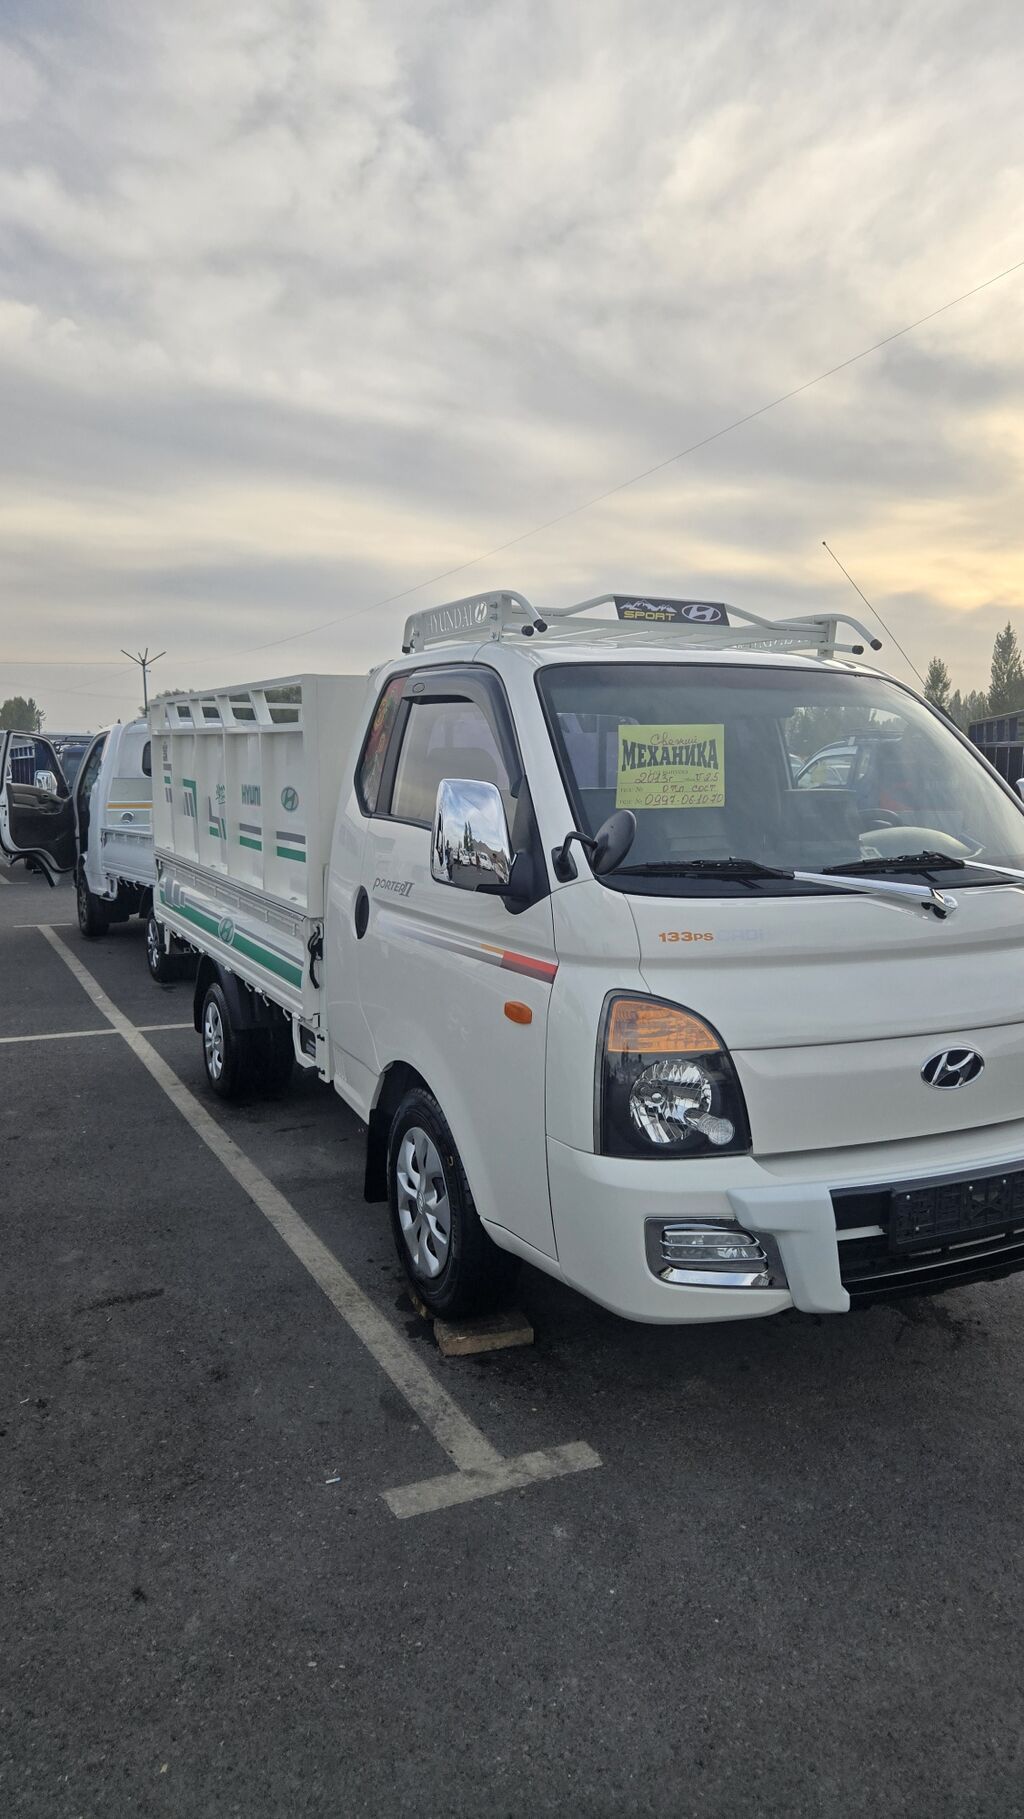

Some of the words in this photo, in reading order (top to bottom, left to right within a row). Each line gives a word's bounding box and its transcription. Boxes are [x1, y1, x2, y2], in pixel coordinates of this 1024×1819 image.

[623, 610, 676, 621] SPORT
[621, 738, 719, 772] МЕХАНИКА
[658, 931, 714, 943] 133PS
